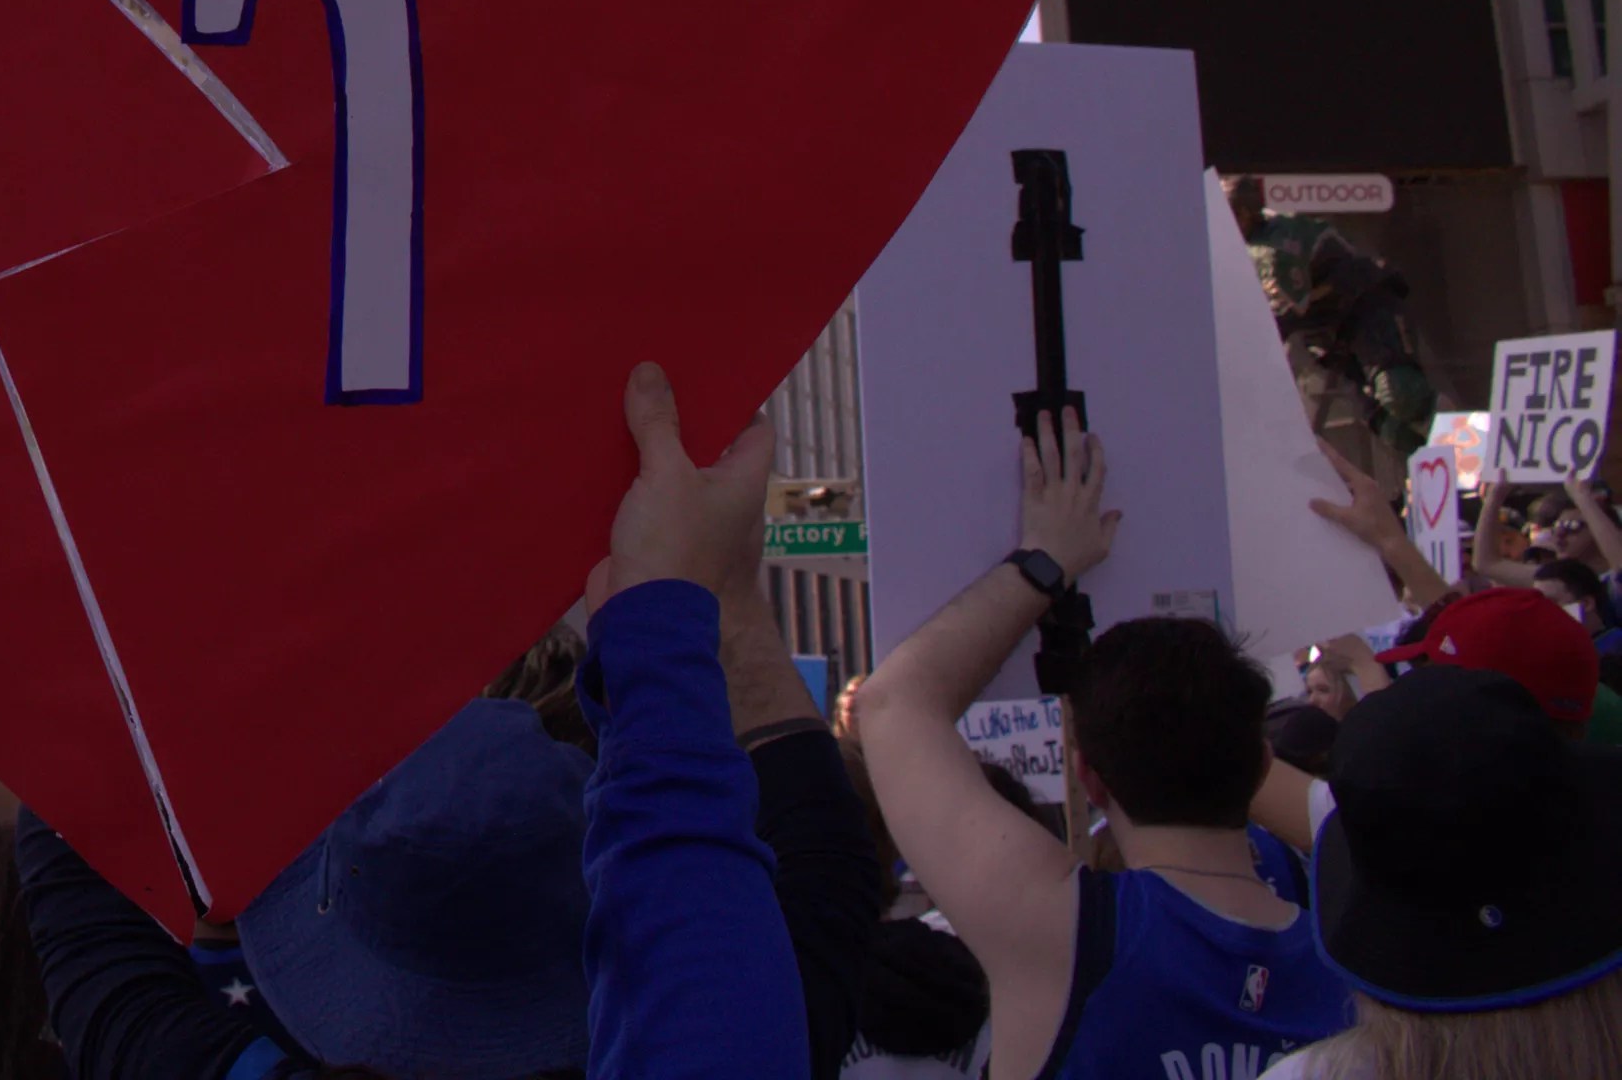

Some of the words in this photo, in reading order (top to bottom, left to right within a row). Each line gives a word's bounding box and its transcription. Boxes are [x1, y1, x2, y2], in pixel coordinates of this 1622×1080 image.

[1269, 183, 1383, 203] OUTDOOR
[1501, 347, 1598, 411] FIRE
[1494, 413, 1600, 473] NICO
